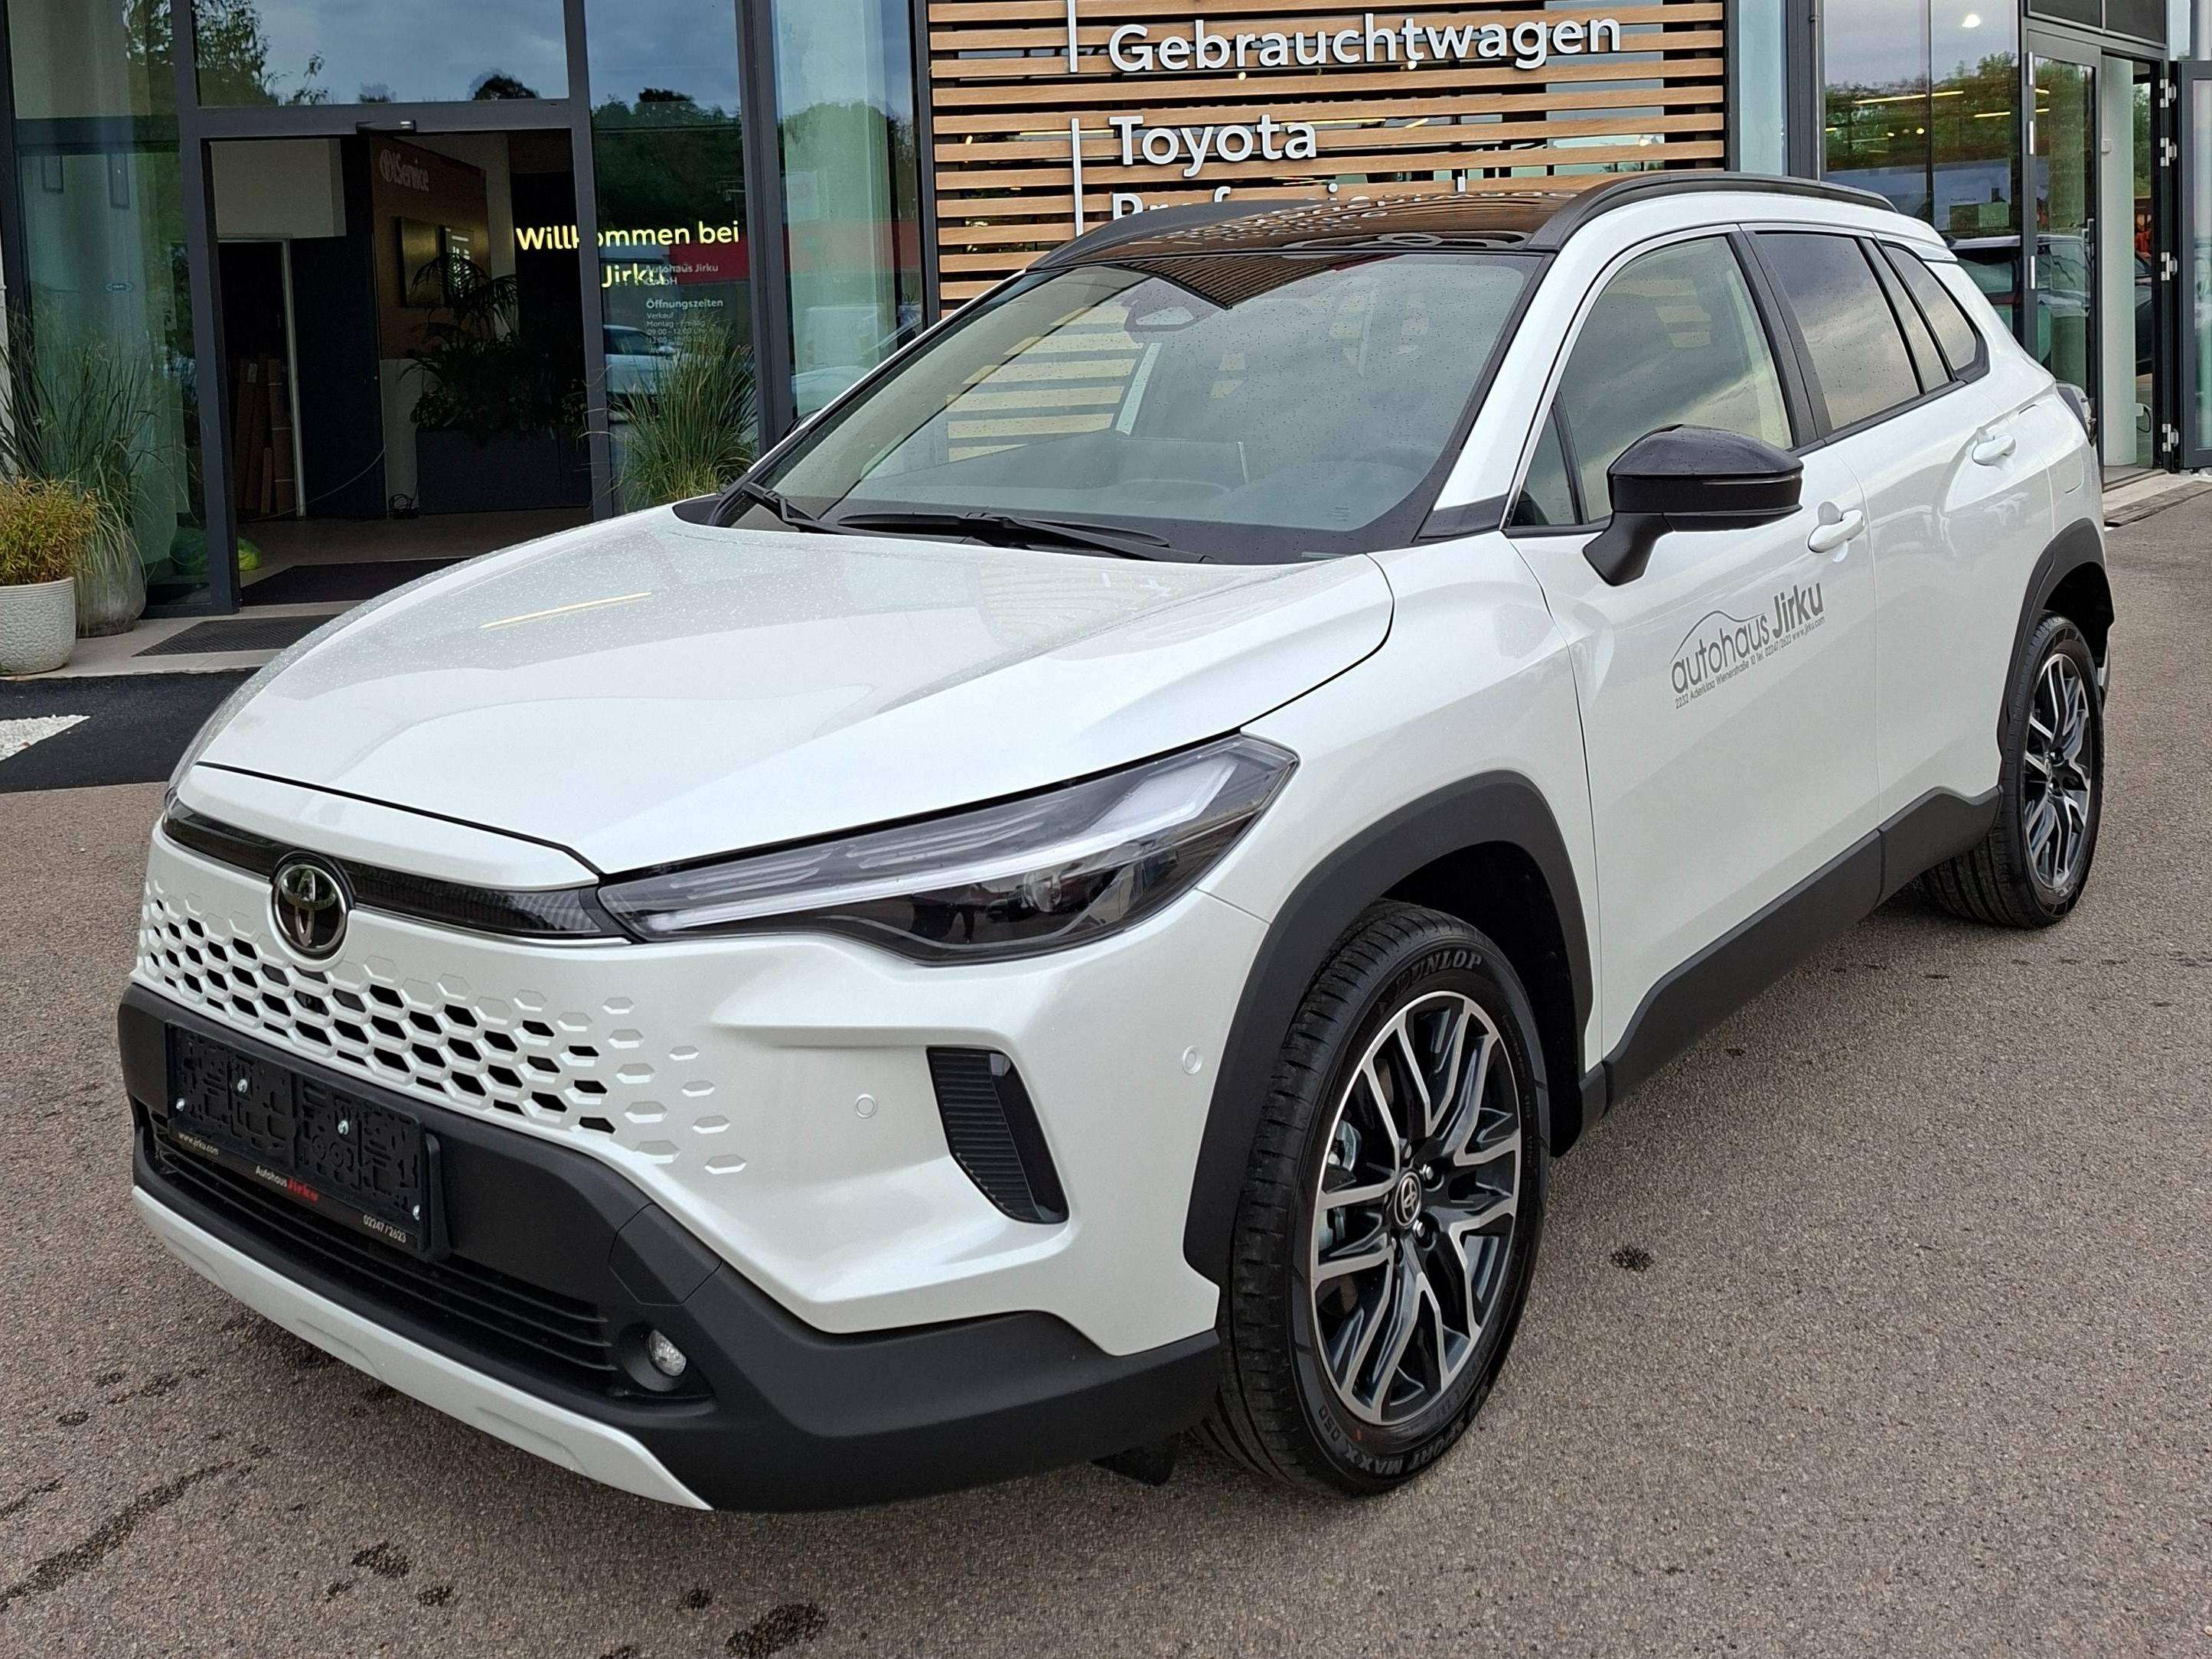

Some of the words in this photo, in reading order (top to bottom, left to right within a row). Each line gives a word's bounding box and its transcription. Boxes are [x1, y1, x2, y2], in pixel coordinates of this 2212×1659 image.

[1109, 13, 1620, 72] Gebrauchtwagen
[1109, 114, 1316, 178] Toyota
[698, 220, 739, 244] bei
[602, 263, 665, 288] Jirku
[645, 263, 693, 274] Autohaus
[694, 262, 719, 272] Jirku
[646, 298, 723, 310] Öffnungszeiten
[1672, 614, 1770, 694] autohaus
[1773, 582, 1824, 639] Jirku
[1396, 949, 1482, 993] DUNLOP
[255, 1165, 287, 1188] Autohaus
[1343, 1436, 1404, 1475] MAXX
